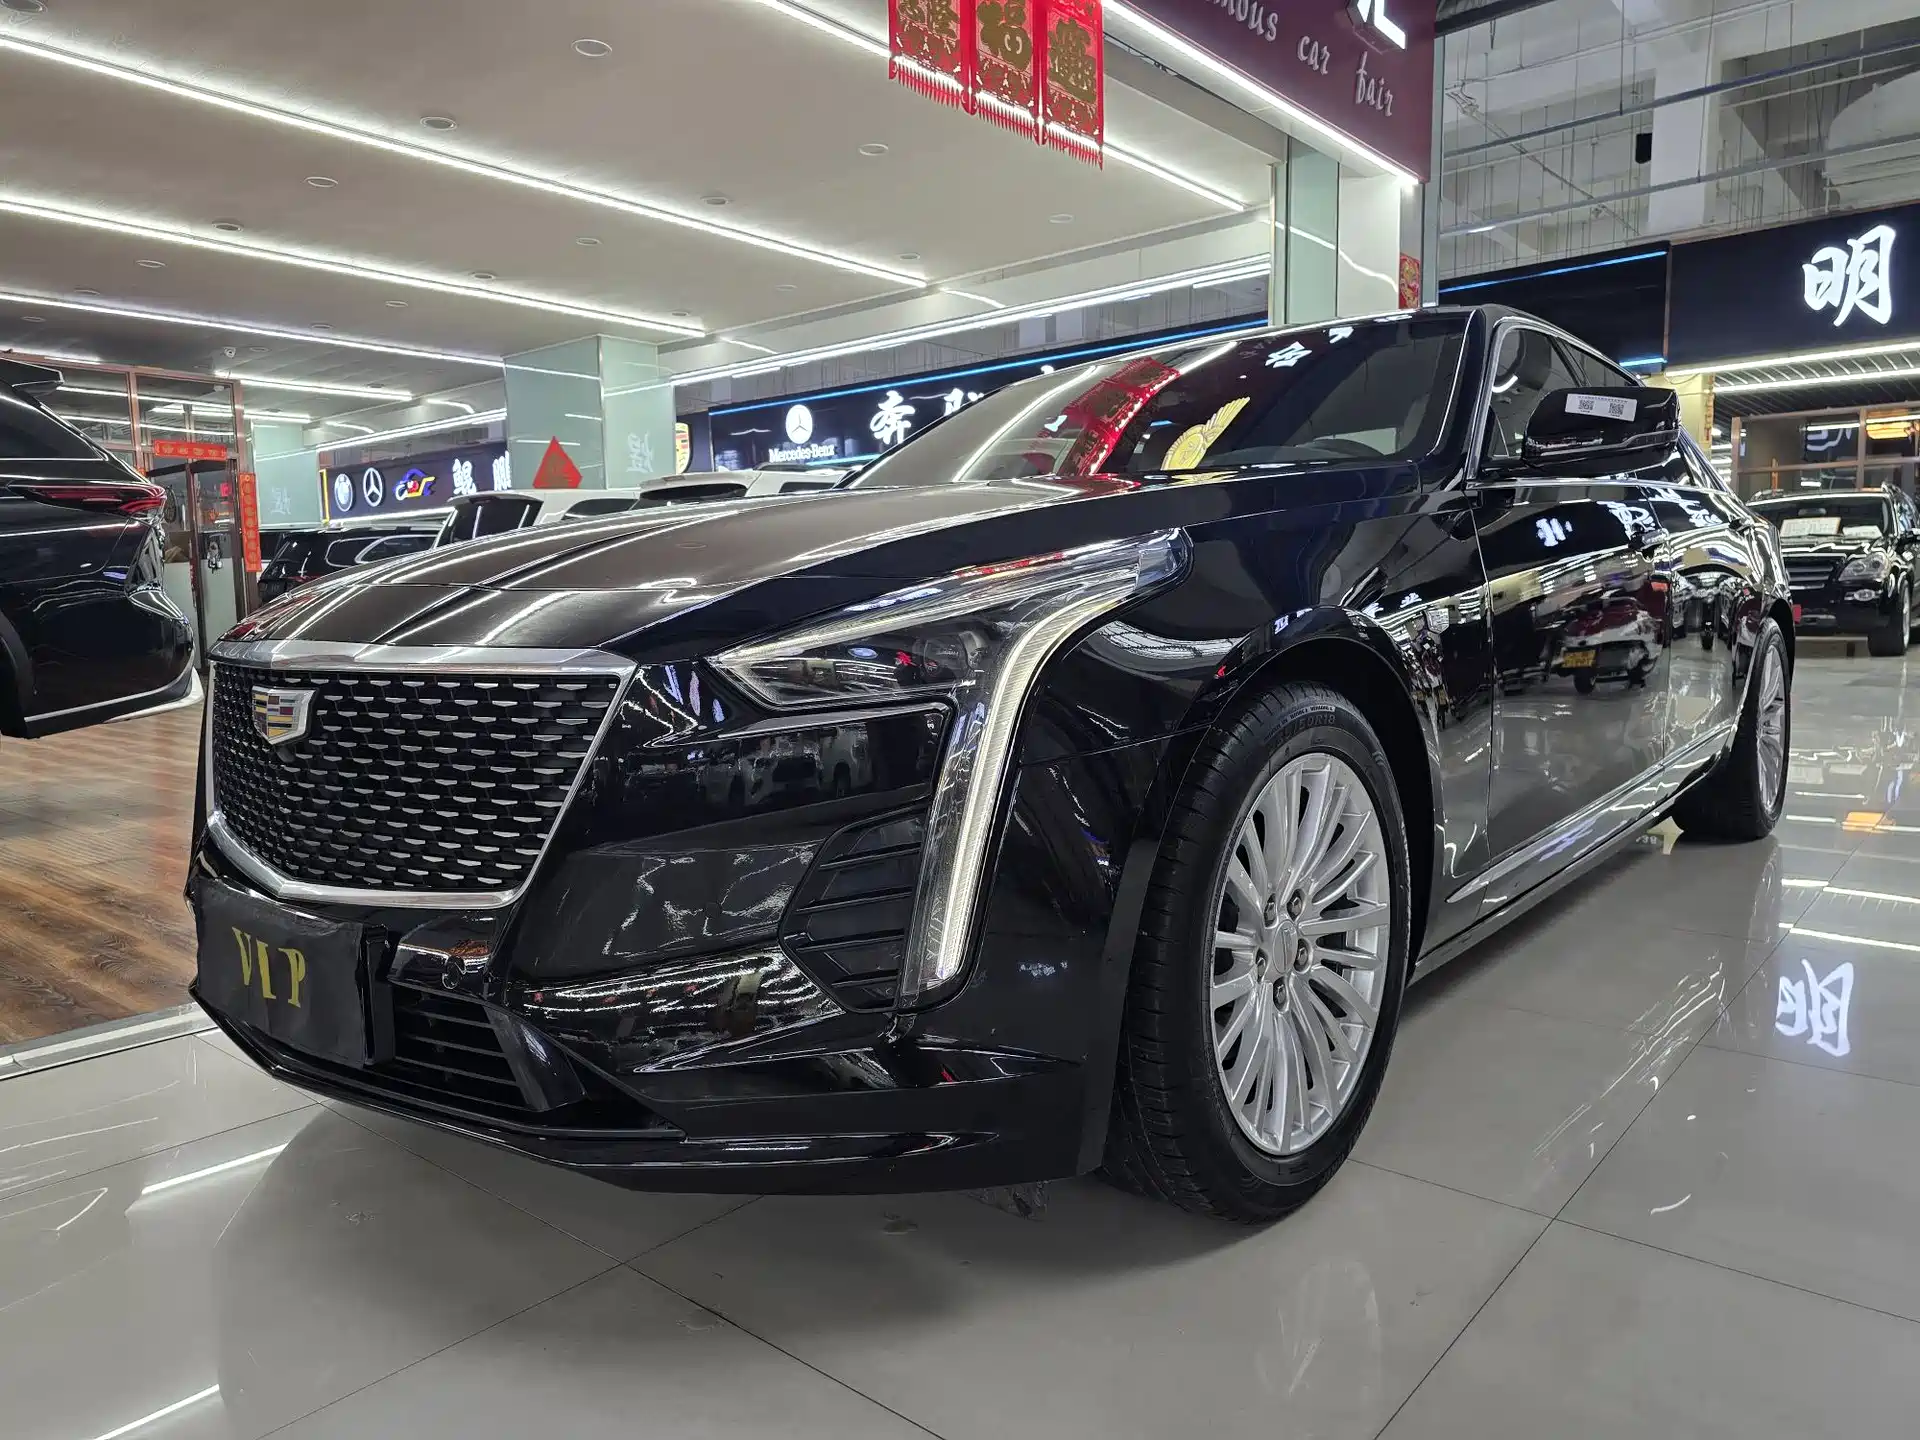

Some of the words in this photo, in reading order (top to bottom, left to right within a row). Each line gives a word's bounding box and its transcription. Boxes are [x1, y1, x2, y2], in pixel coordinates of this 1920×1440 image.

[1297, 35, 1331, 75] car
[1802, 224, 1897, 327] 明
[768, 443, 836, 463] Mercedes-Benz
[231, 926, 307, 1009] VIP
